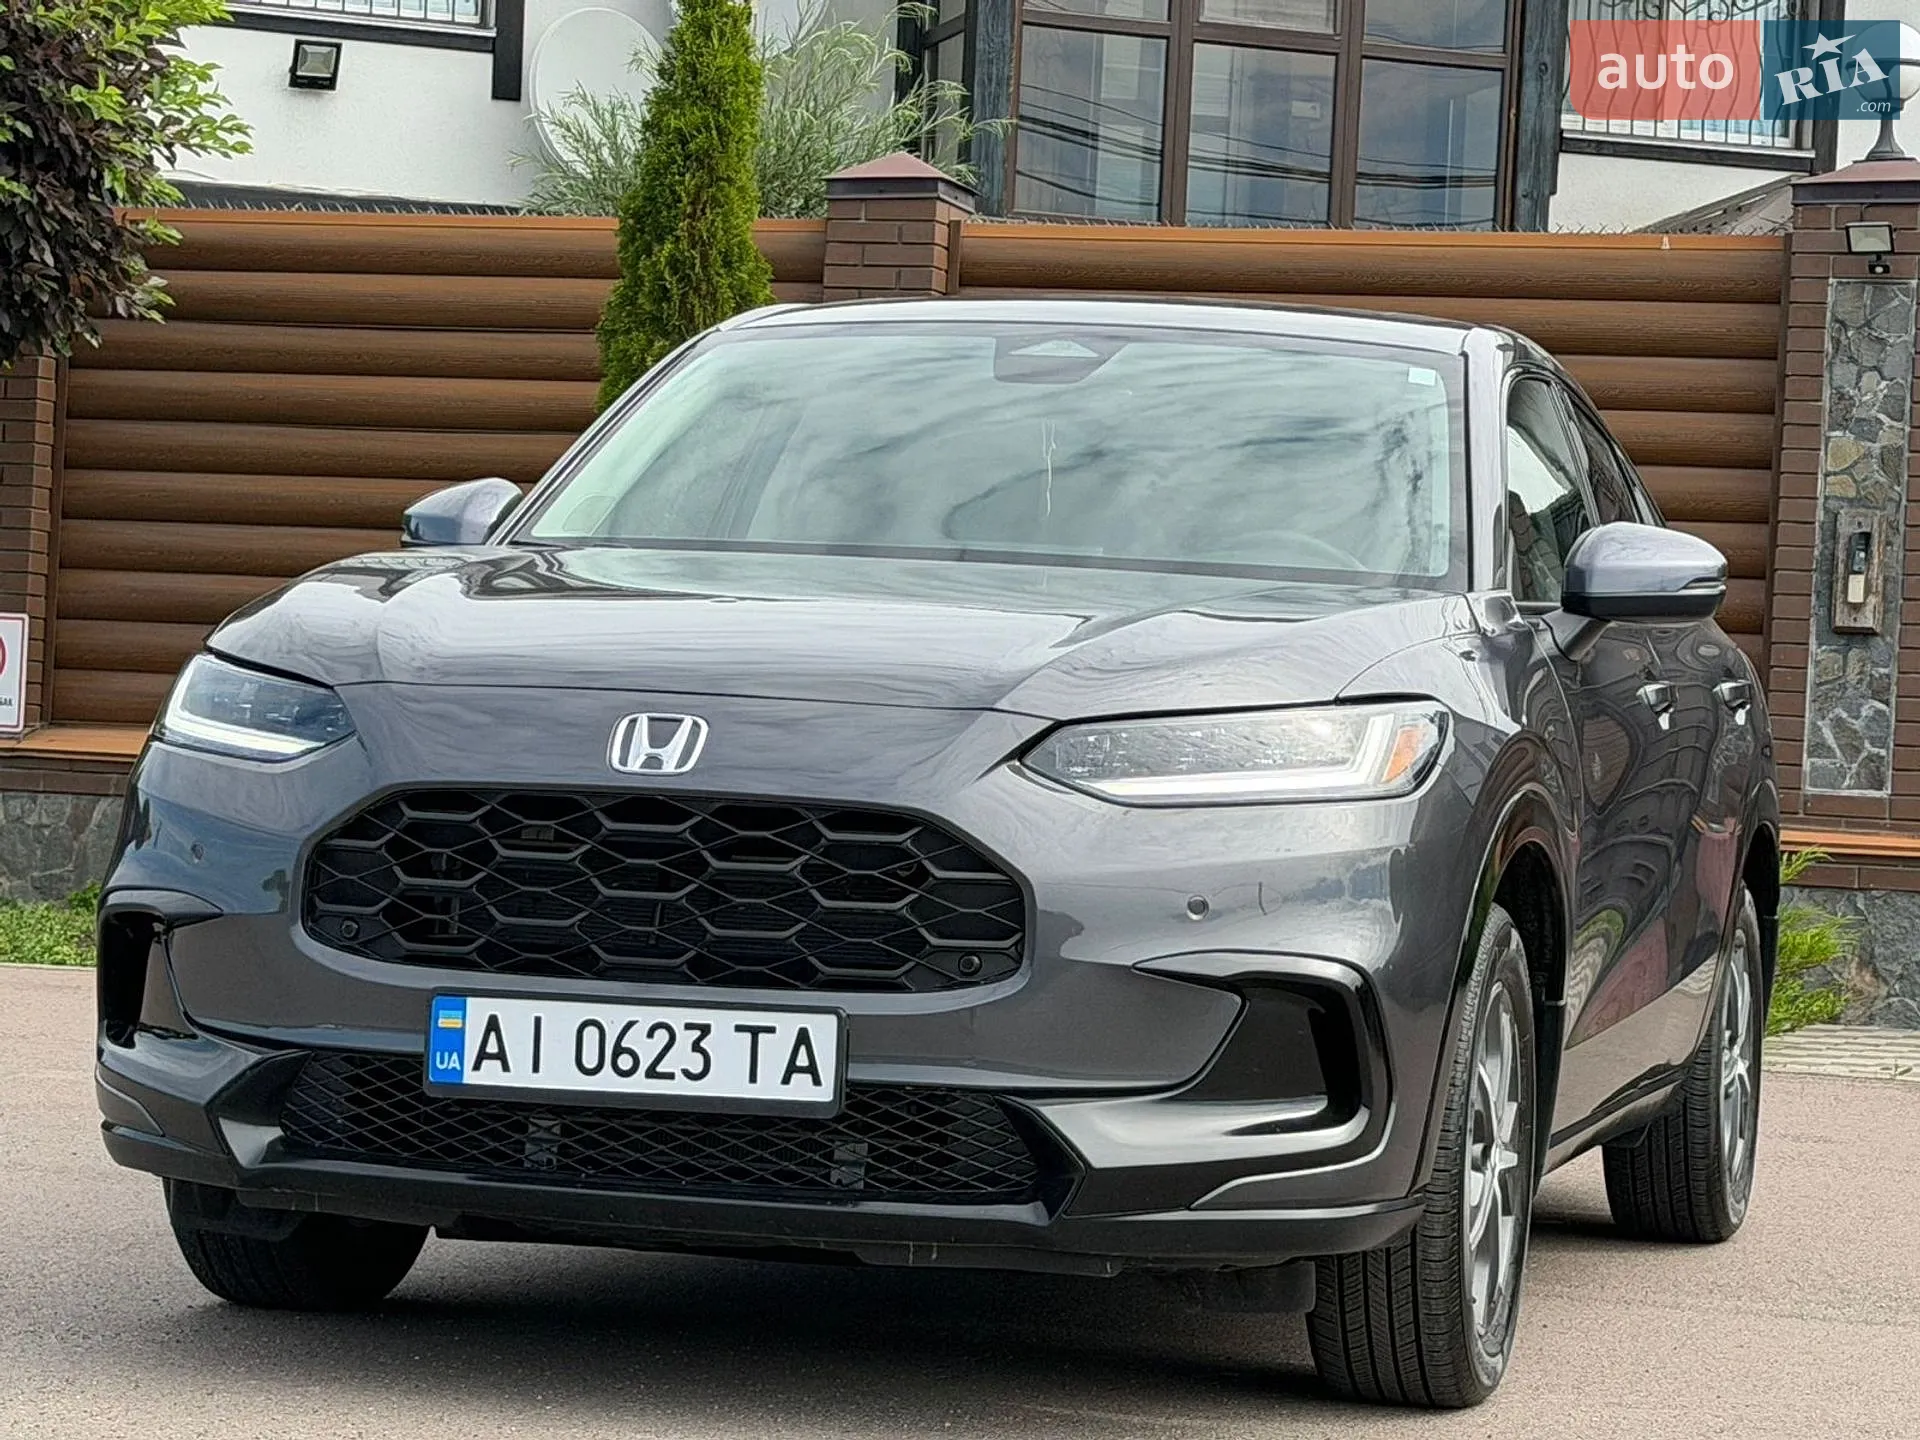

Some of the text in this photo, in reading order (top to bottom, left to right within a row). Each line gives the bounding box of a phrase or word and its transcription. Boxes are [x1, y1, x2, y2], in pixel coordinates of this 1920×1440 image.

[435, 1051, 461, 1071] UA
[471, 1013, 823, 1087] AI 0623 TA
